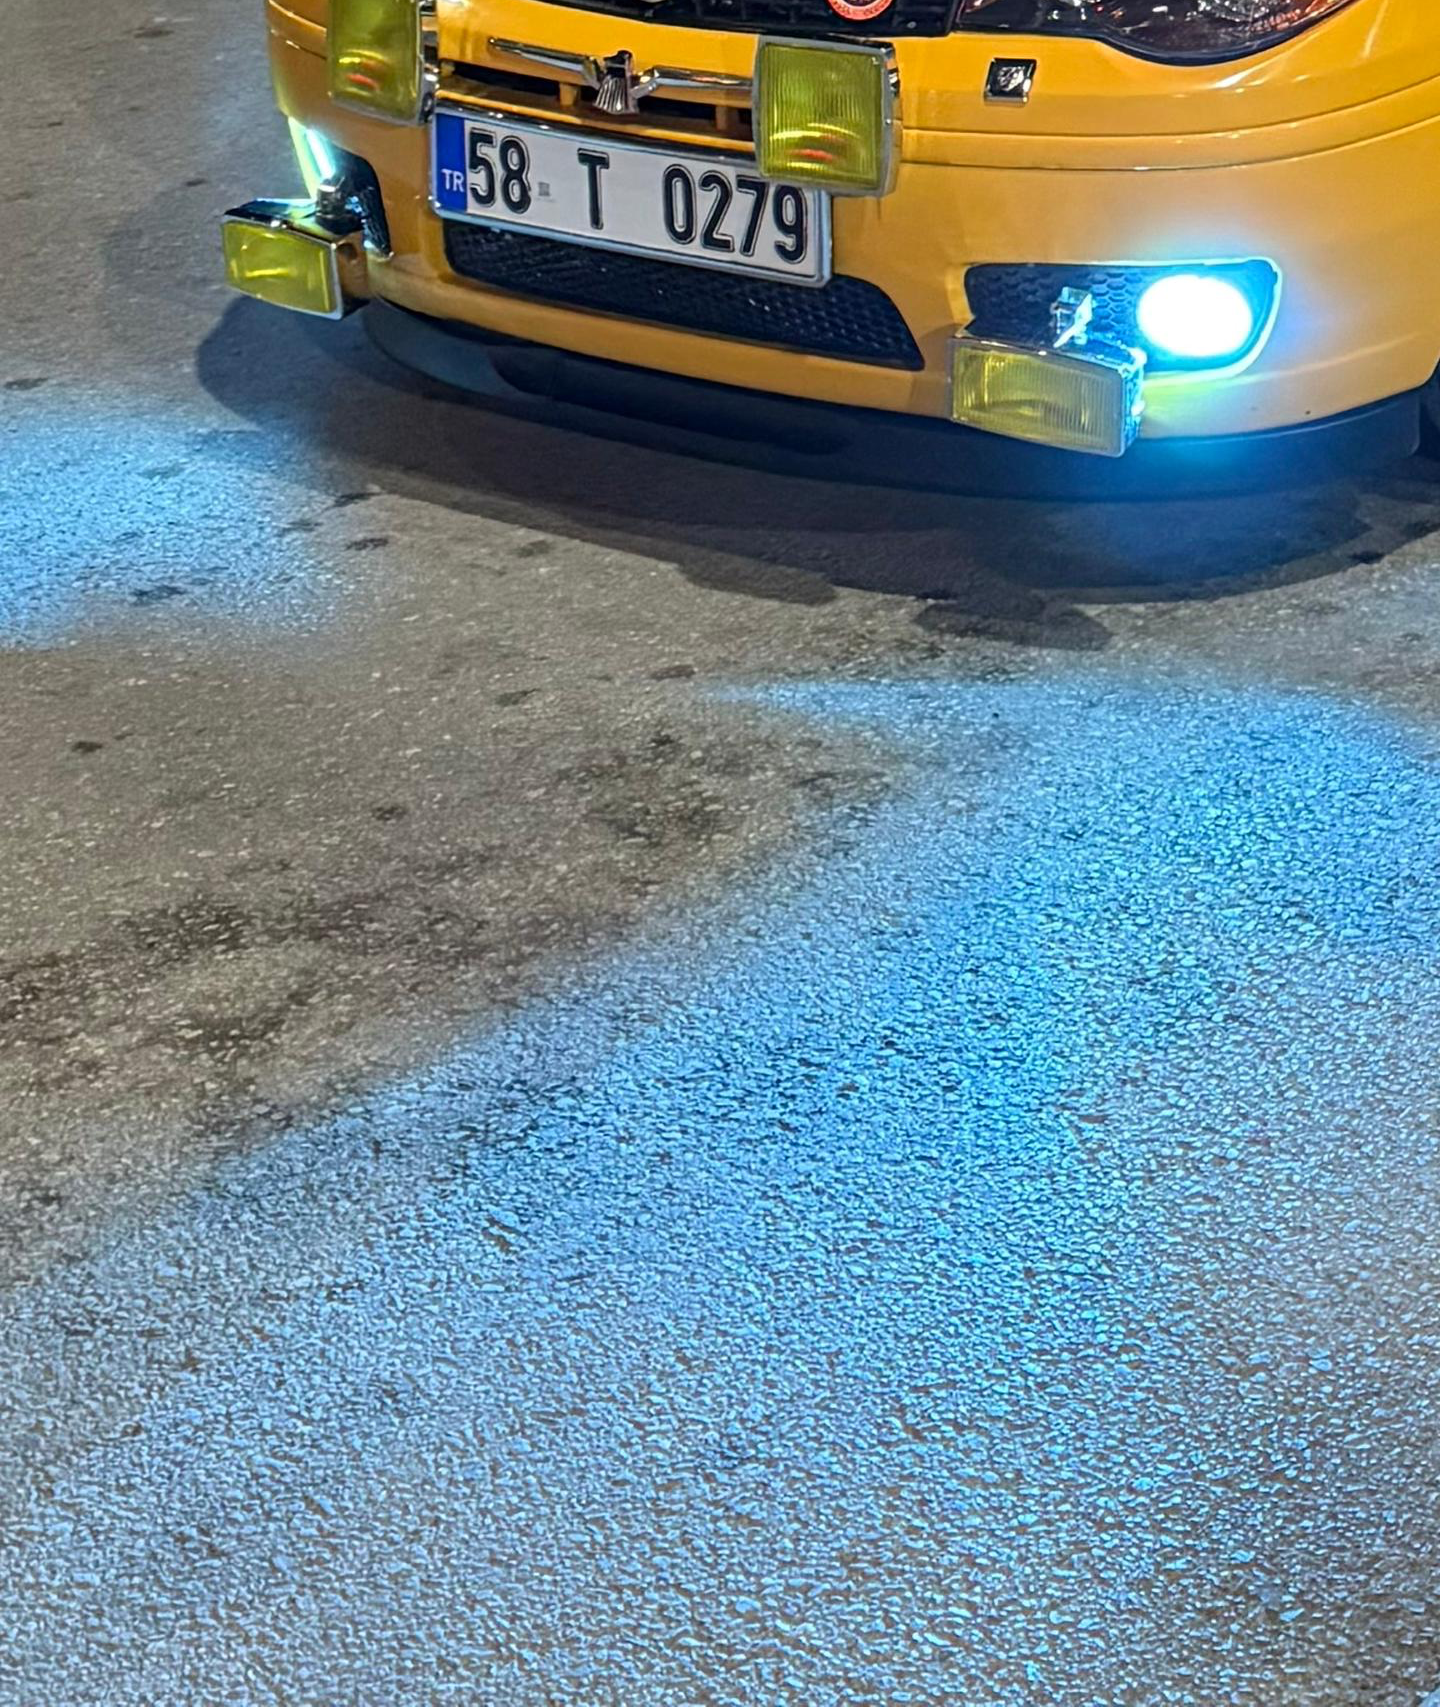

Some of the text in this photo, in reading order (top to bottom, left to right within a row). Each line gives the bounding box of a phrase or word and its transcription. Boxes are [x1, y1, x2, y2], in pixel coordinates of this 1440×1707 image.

[441, 167, 465, 193] TR
[469, 126, 808, 265] 58 T 0279
